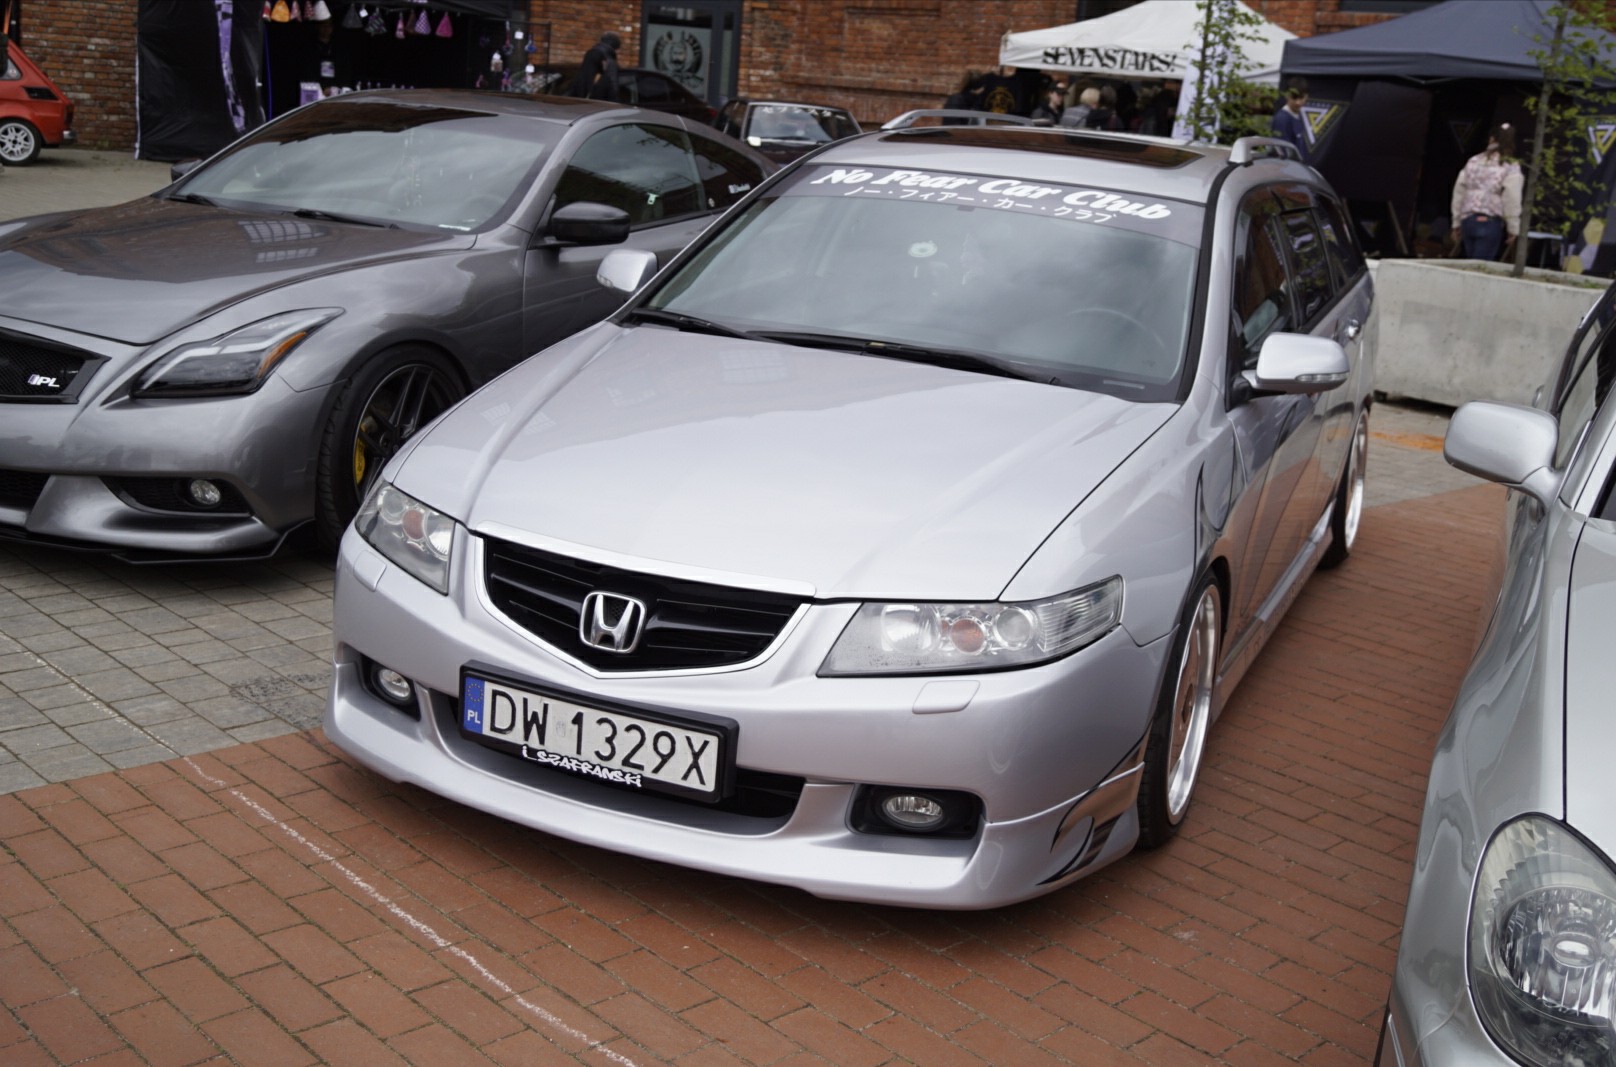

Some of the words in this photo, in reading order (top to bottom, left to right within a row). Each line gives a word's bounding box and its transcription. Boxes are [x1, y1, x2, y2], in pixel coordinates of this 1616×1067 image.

[1042, 46, 1178, 73] SEVENSTARS!
[810, 169, 874, 185] No
[870, 170, 979, 190] Fear
[978, 179, 1062, 199] Car
[1062, 190, 1172, 219] Club
[467, 709, 481, 724] PL
[489, 689, 549, 746] DW
[571, 710, 711, 786] 1329X
